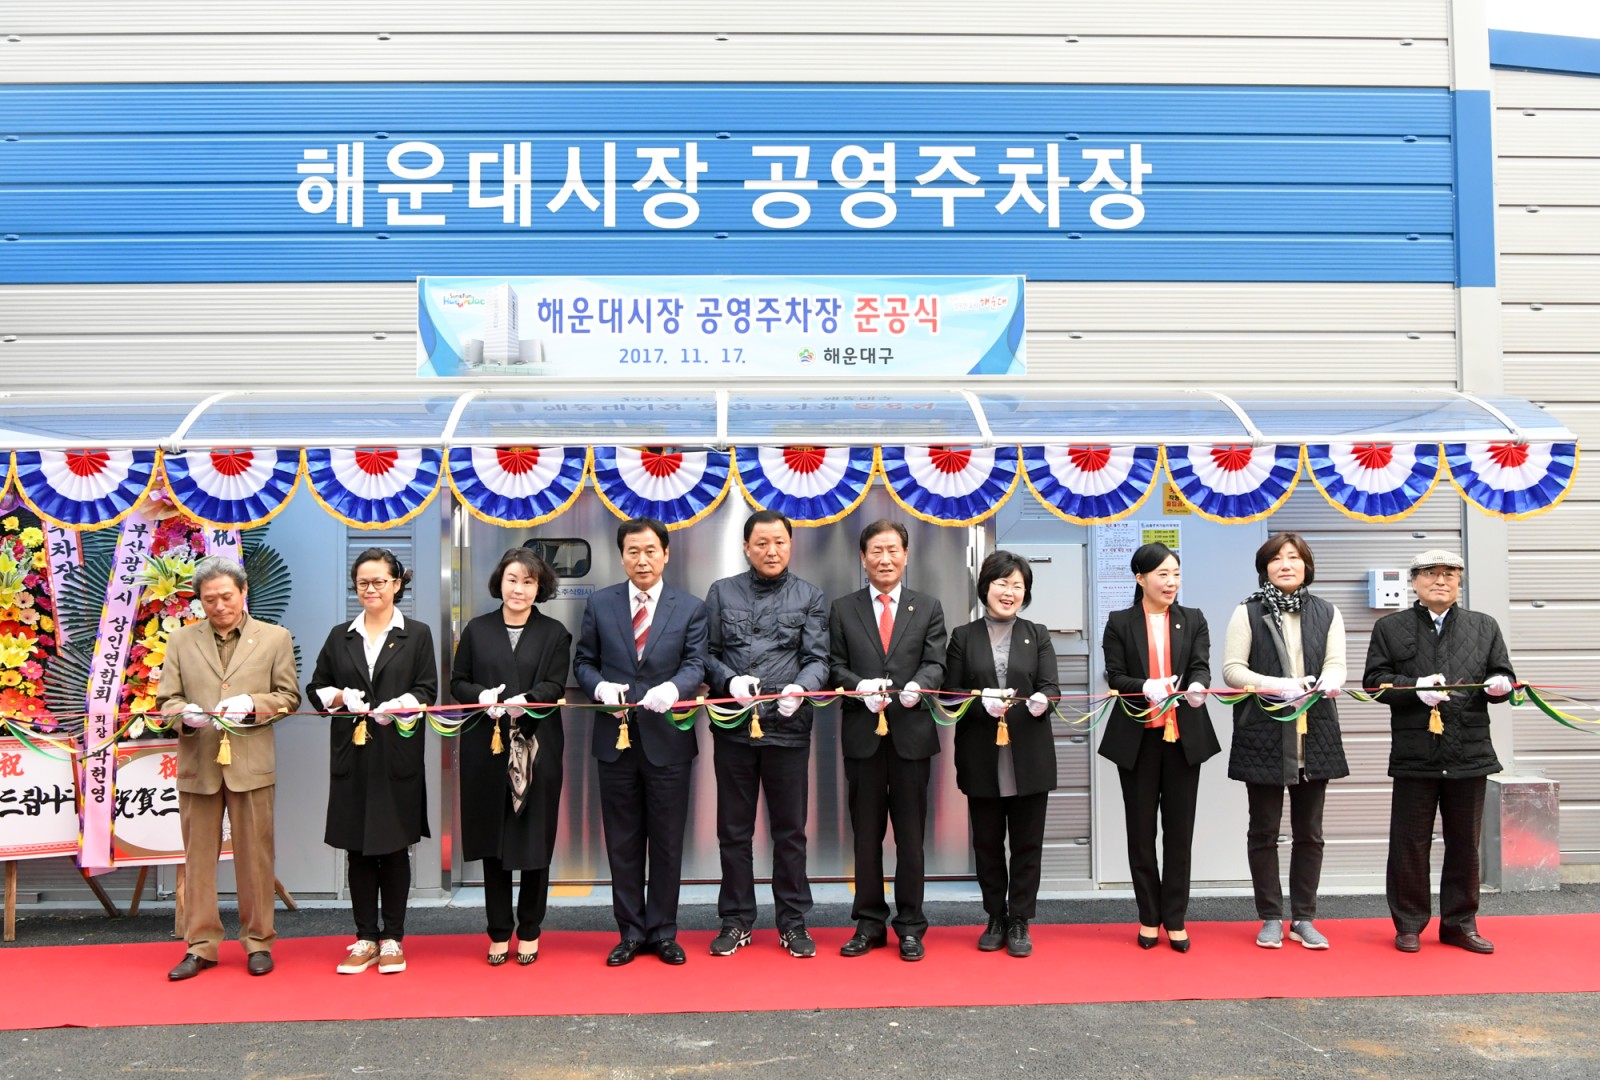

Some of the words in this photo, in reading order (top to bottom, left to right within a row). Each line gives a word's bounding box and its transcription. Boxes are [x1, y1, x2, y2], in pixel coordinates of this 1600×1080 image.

[297, 141, 708, 229] 해운대시장
[743, 142, 1153, 230] 공영주차장
[537, 297, 684, 334] 해운대시장
[696, 297, 842, 334] 공영주차장
[854, 297, 938, 334] 준공식
[619, 348, 668, 364] 2017.
[680, 348, 708, 364] 11.
[721, 348, 746, 364] 17.
[823, 347, 894, 365] 해운대구
[93, 616, 129, 704] 상인연합회
[95, 715, 107, 739] 회장
